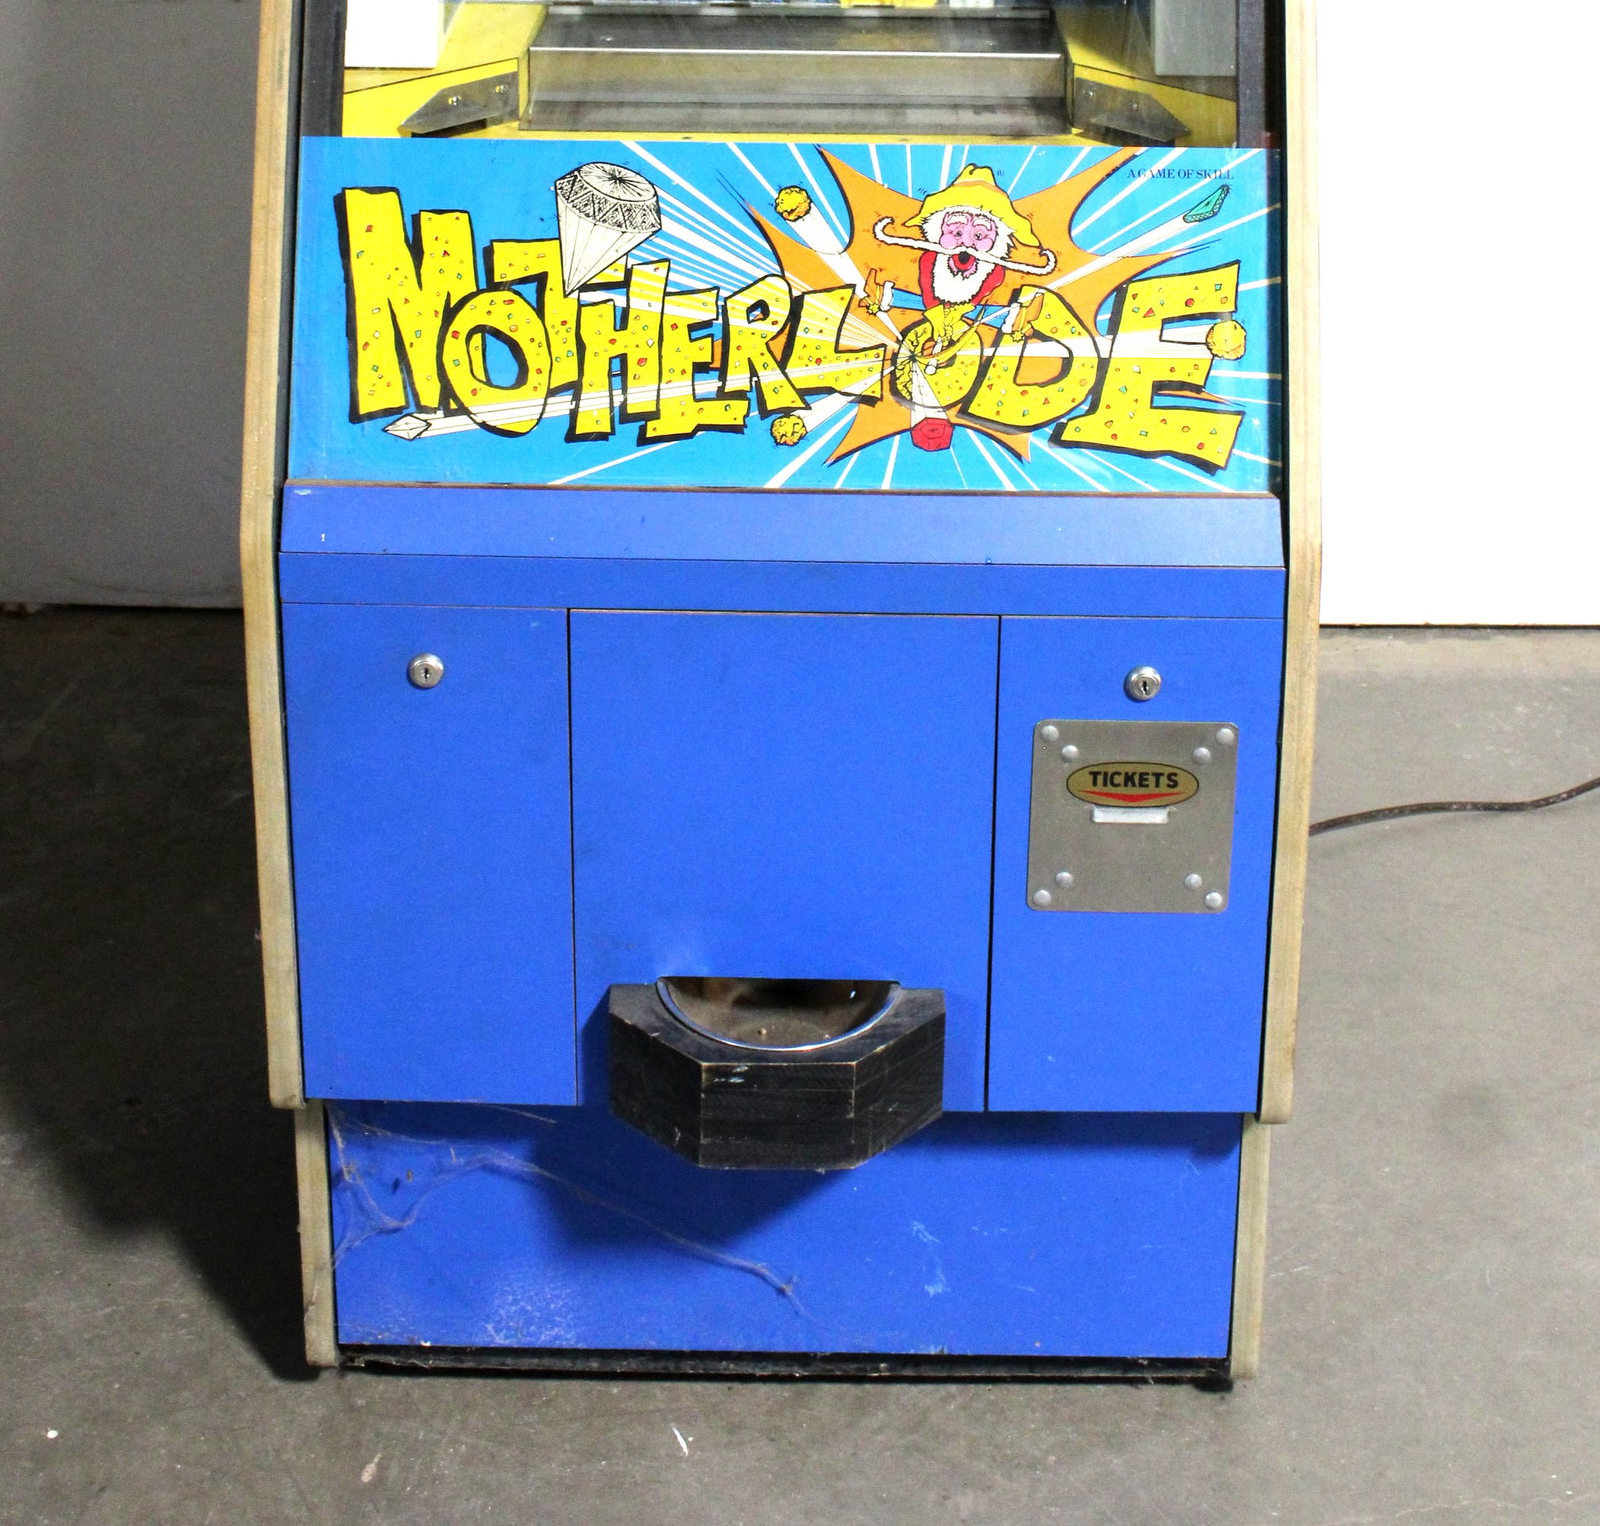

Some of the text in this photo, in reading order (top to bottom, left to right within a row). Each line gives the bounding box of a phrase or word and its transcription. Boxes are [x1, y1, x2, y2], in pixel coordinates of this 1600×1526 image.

[1127, 169, 1235, 180] A GAME OF SKILL
[1089, 771, 1179, 789] TICKETS
